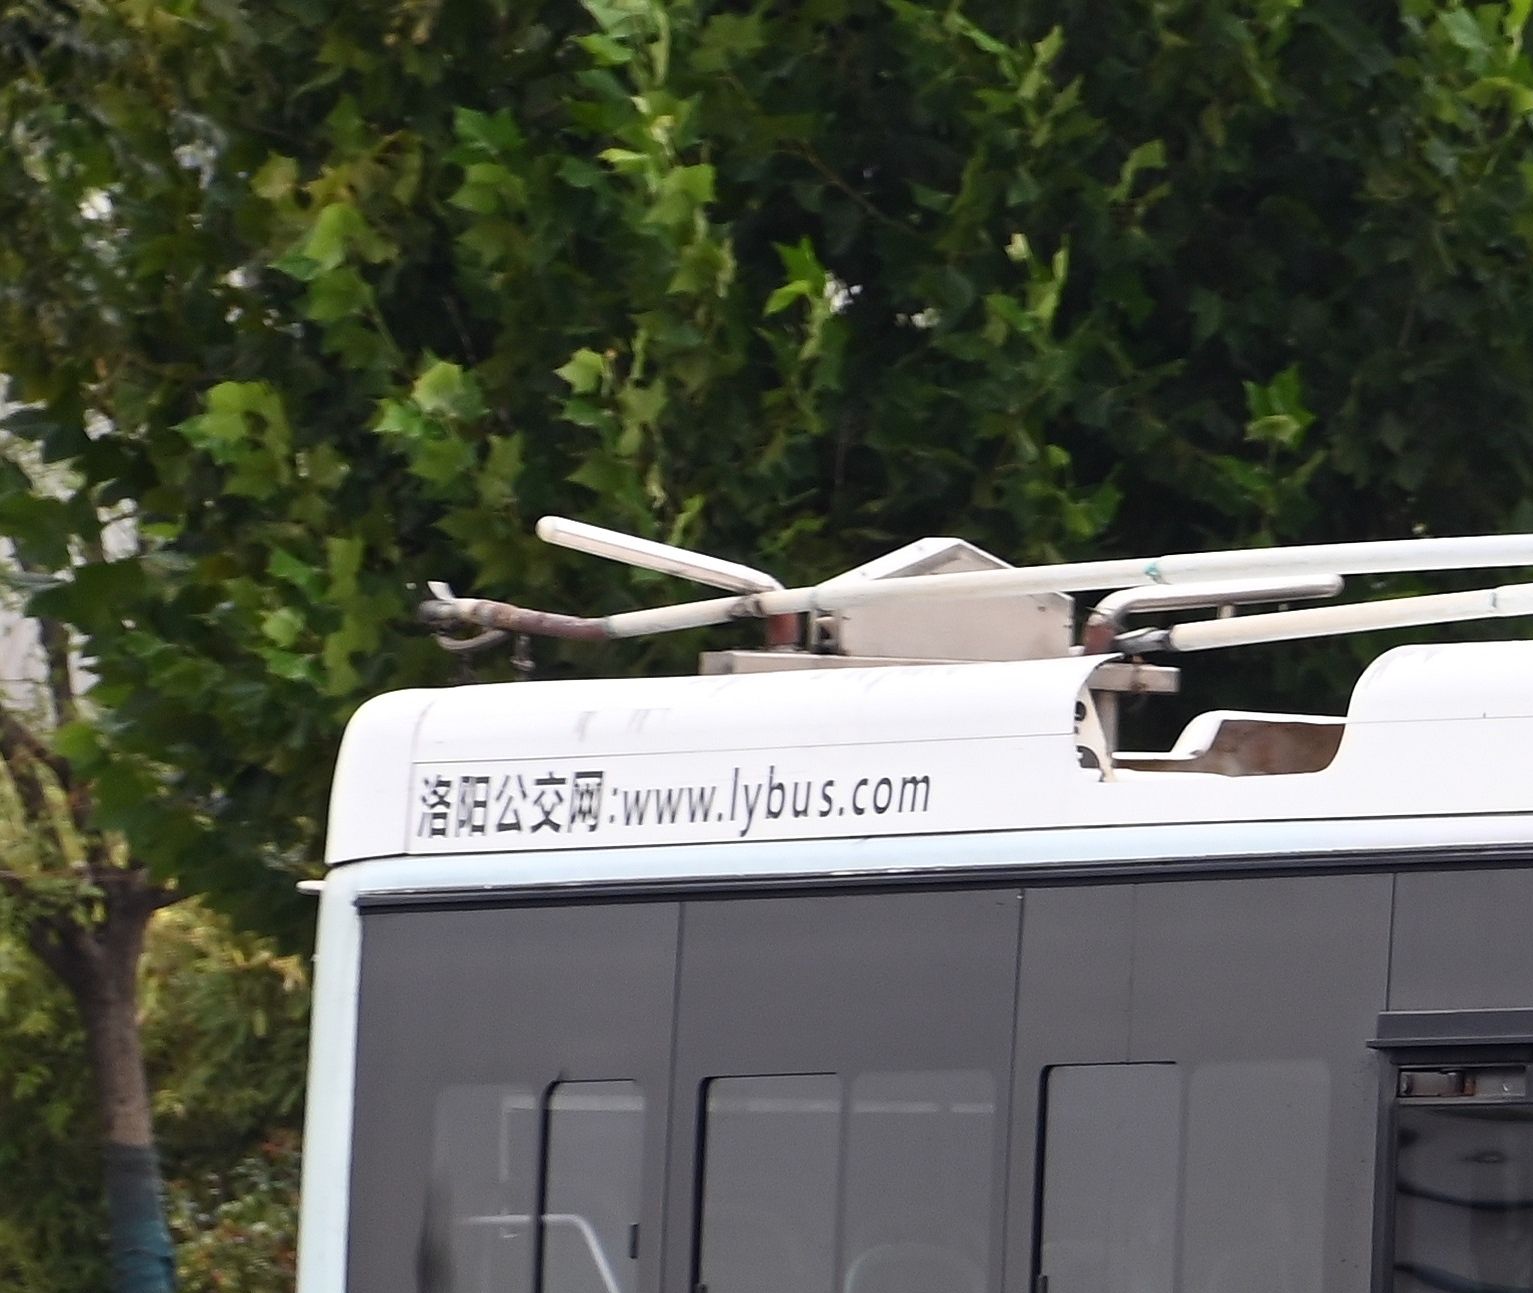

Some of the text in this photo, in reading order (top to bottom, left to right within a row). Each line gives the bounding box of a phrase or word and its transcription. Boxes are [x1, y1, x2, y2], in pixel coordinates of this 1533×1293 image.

[417, 765, 931, 840] 洛阳公交网:www.lybus.com
